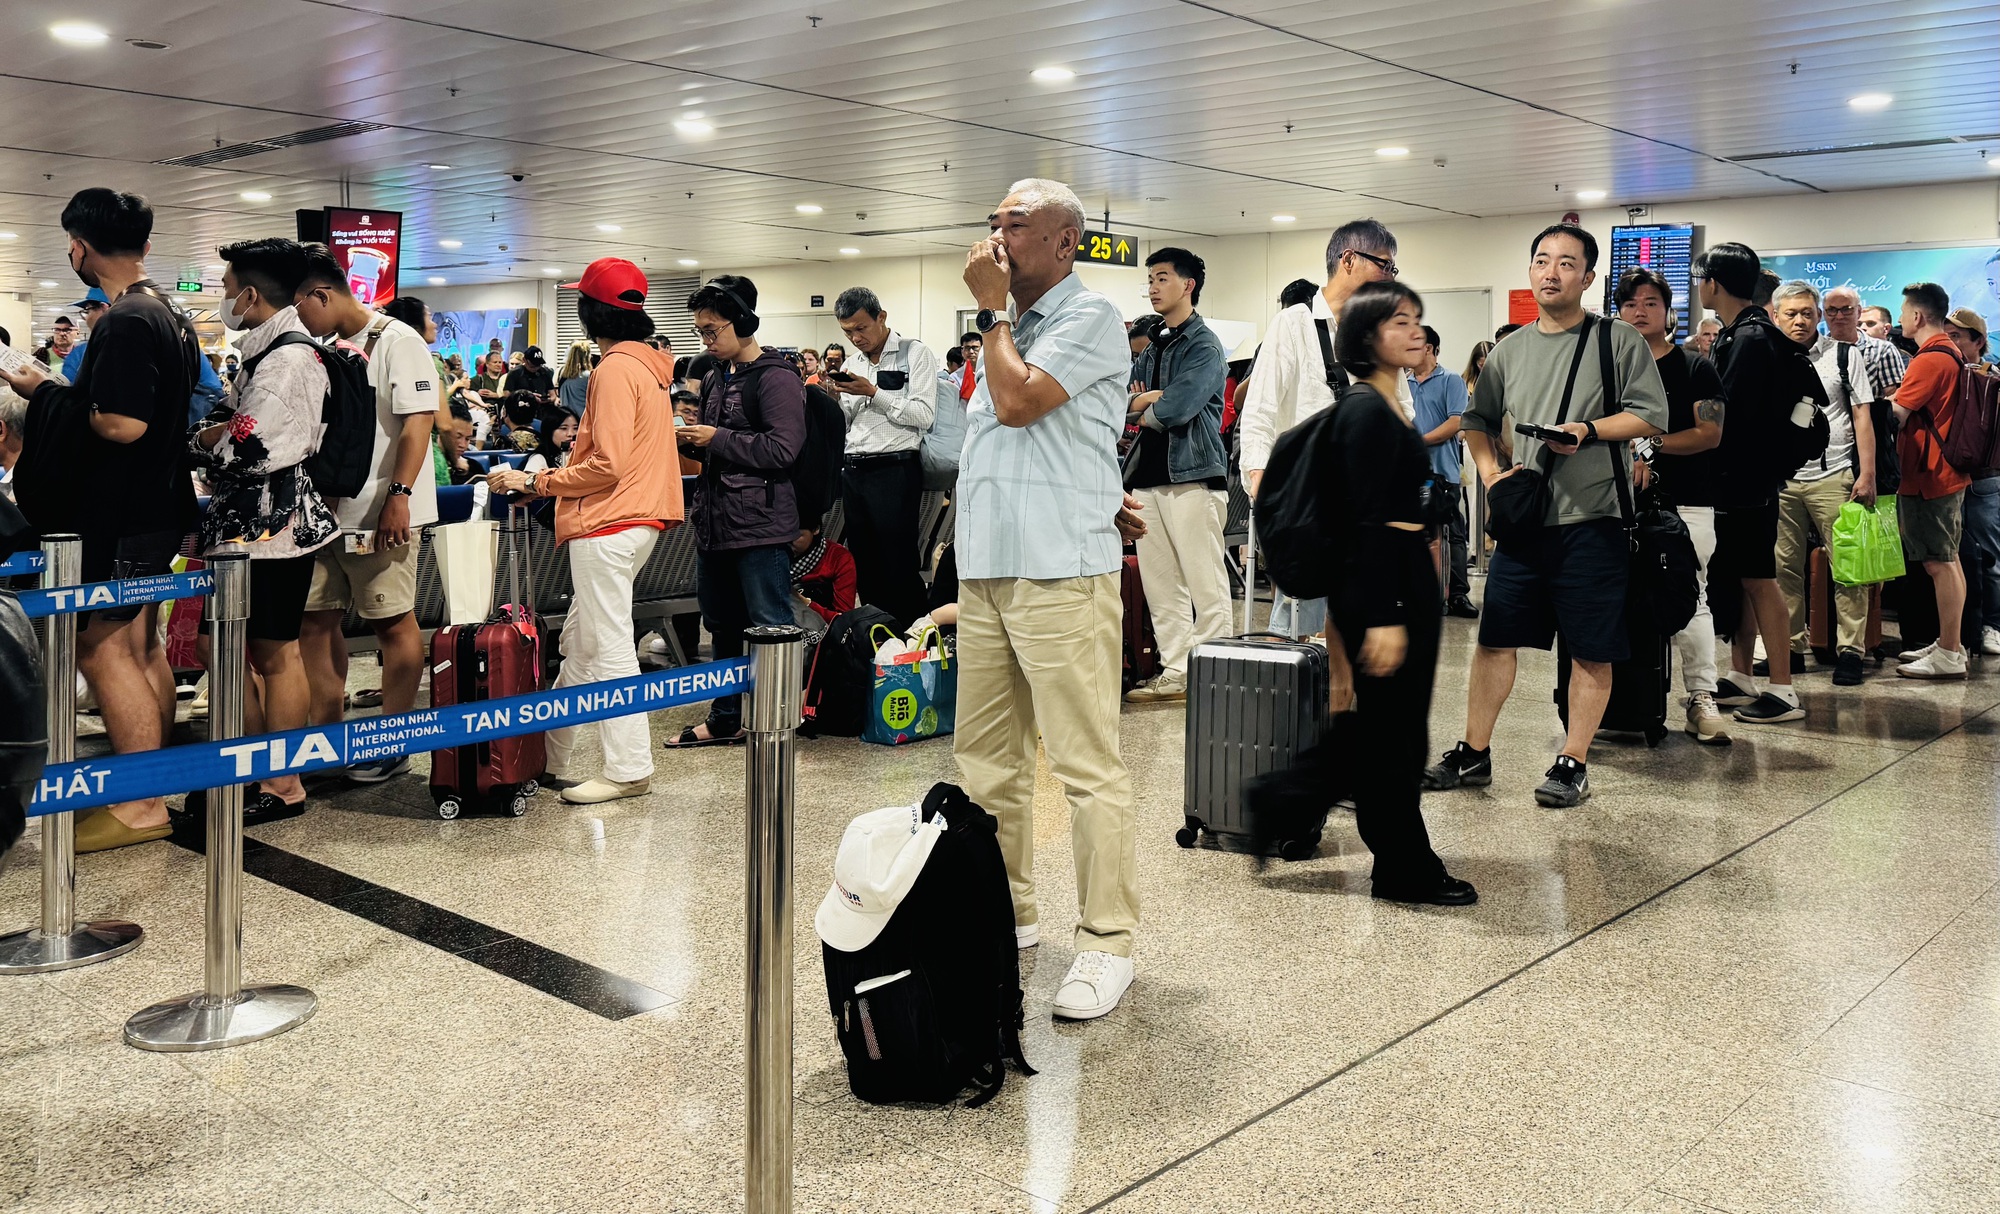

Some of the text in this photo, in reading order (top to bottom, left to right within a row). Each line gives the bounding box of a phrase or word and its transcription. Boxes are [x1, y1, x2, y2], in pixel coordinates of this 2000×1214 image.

[1090, 235, 1111, 260] 25
[123, 584, 178, 596] INTERNATIONAL
[156, 576, 175, 584] NHAT
[187, 574, 214, 590] TAN
[46, 585, 116, 610] TIA
[123, 594, 155, 604] AIRPORT
[461, 707, 511, 734] TAN
[518, 697, 569, 724] SON
[576, 685, 638, 714] NHAT
[889, 696, 897, 722] Markt
[353, 711, 439, 733] TAN SON NHAT
[352, 724, 446, 748] INTERNATIONAL
[220, 732, 340, 778] TIA
[352, 743, 406, 760] AIRPORT
[31, 765, 112, 804] HẤT
